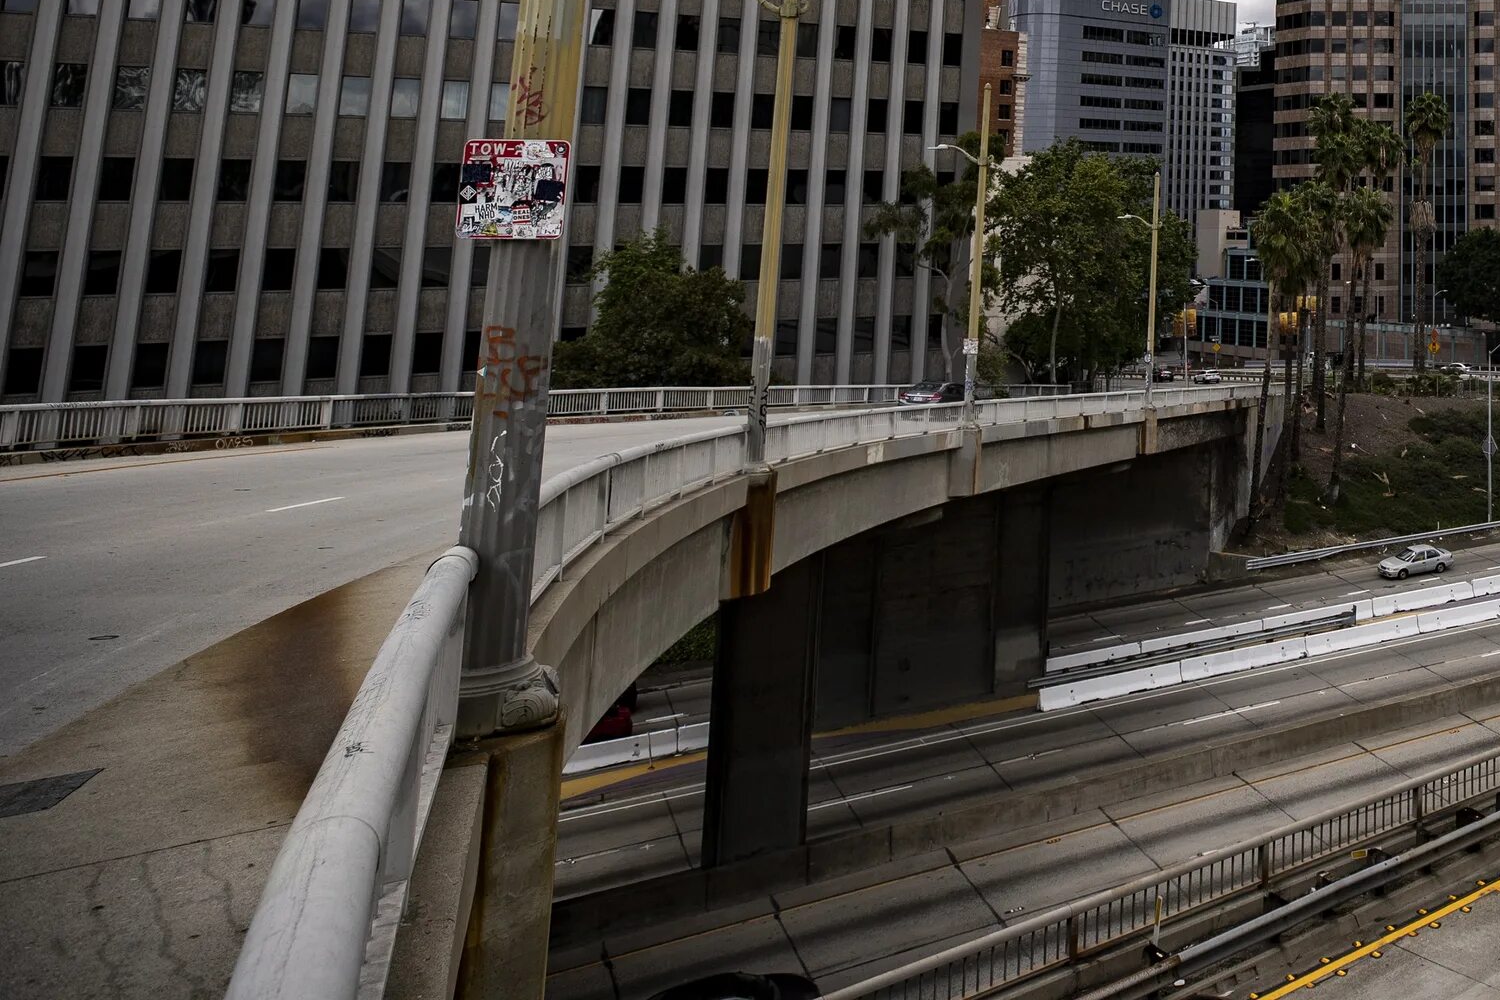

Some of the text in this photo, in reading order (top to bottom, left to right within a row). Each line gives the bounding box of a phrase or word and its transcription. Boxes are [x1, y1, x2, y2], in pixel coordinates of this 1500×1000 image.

[1101, 0, 1148, 15] CHASE
[470, 142, 523, 156] TOW-A
[474, 203, 498, 213] HARM
